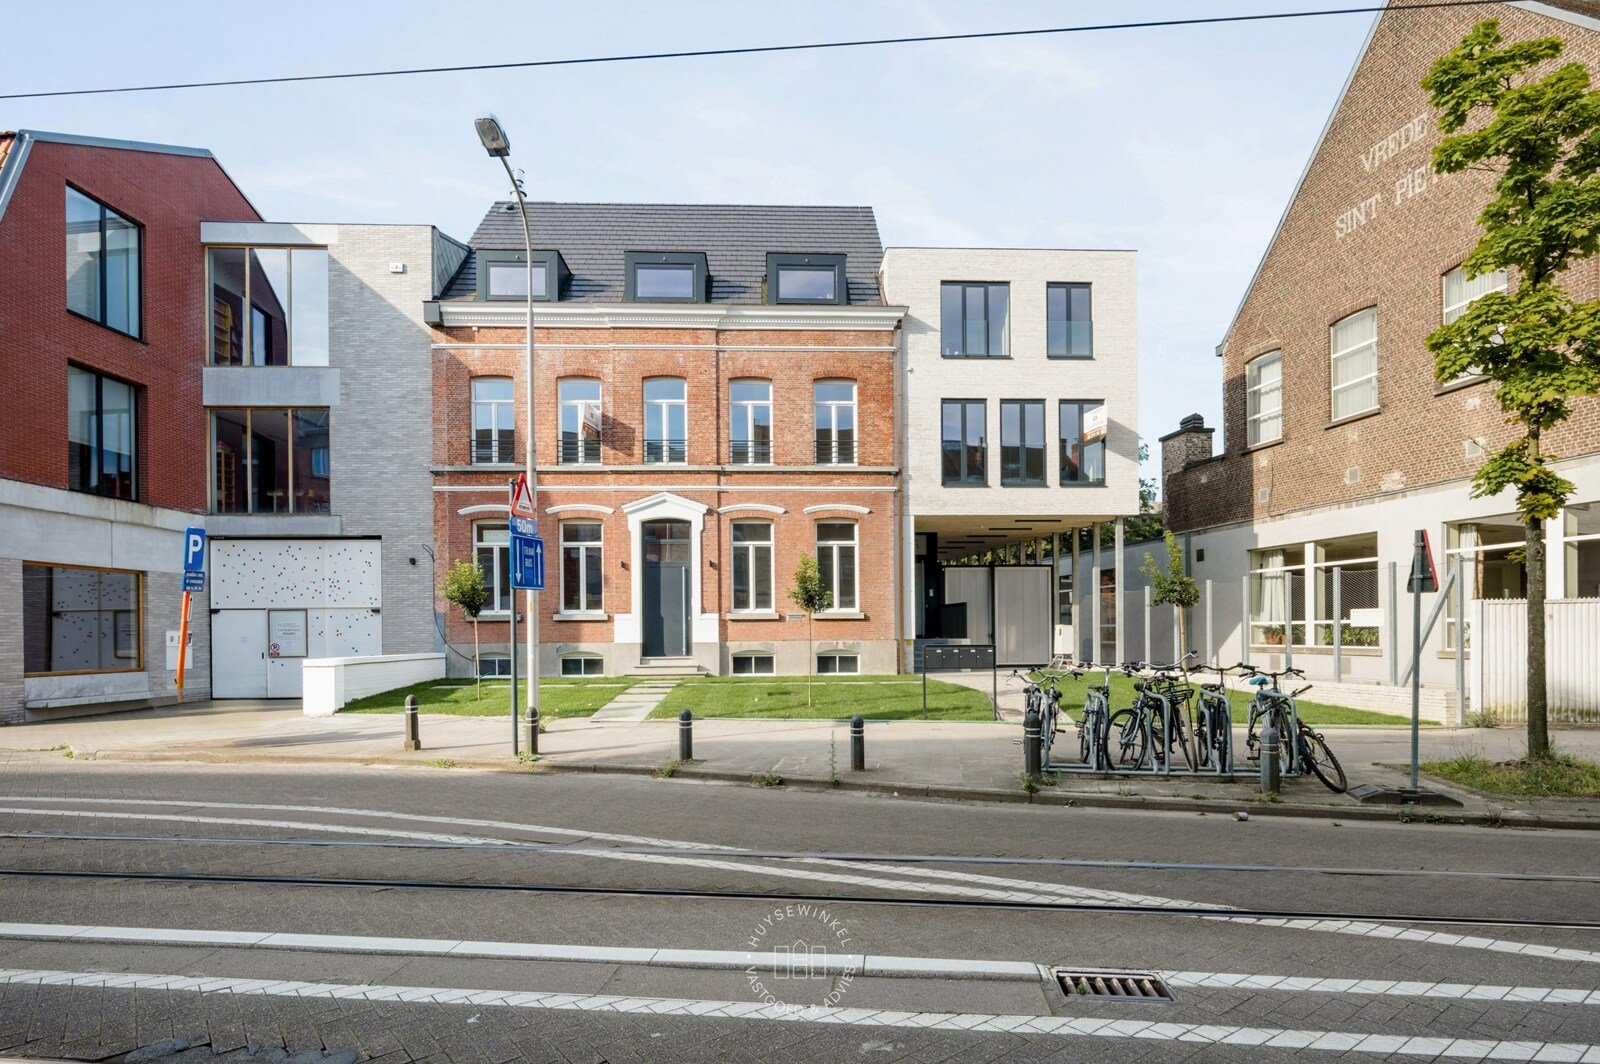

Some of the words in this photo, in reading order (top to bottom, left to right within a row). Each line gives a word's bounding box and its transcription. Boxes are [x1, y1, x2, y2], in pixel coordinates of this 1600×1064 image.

[1360, 112, 1428, 173] VREDE
[1335, 192, 1382, 240] SINT
[516, 518, 534, 534] 50m
[188, 534, 203, 564] P
[524, 558, 533, 568] BUS
